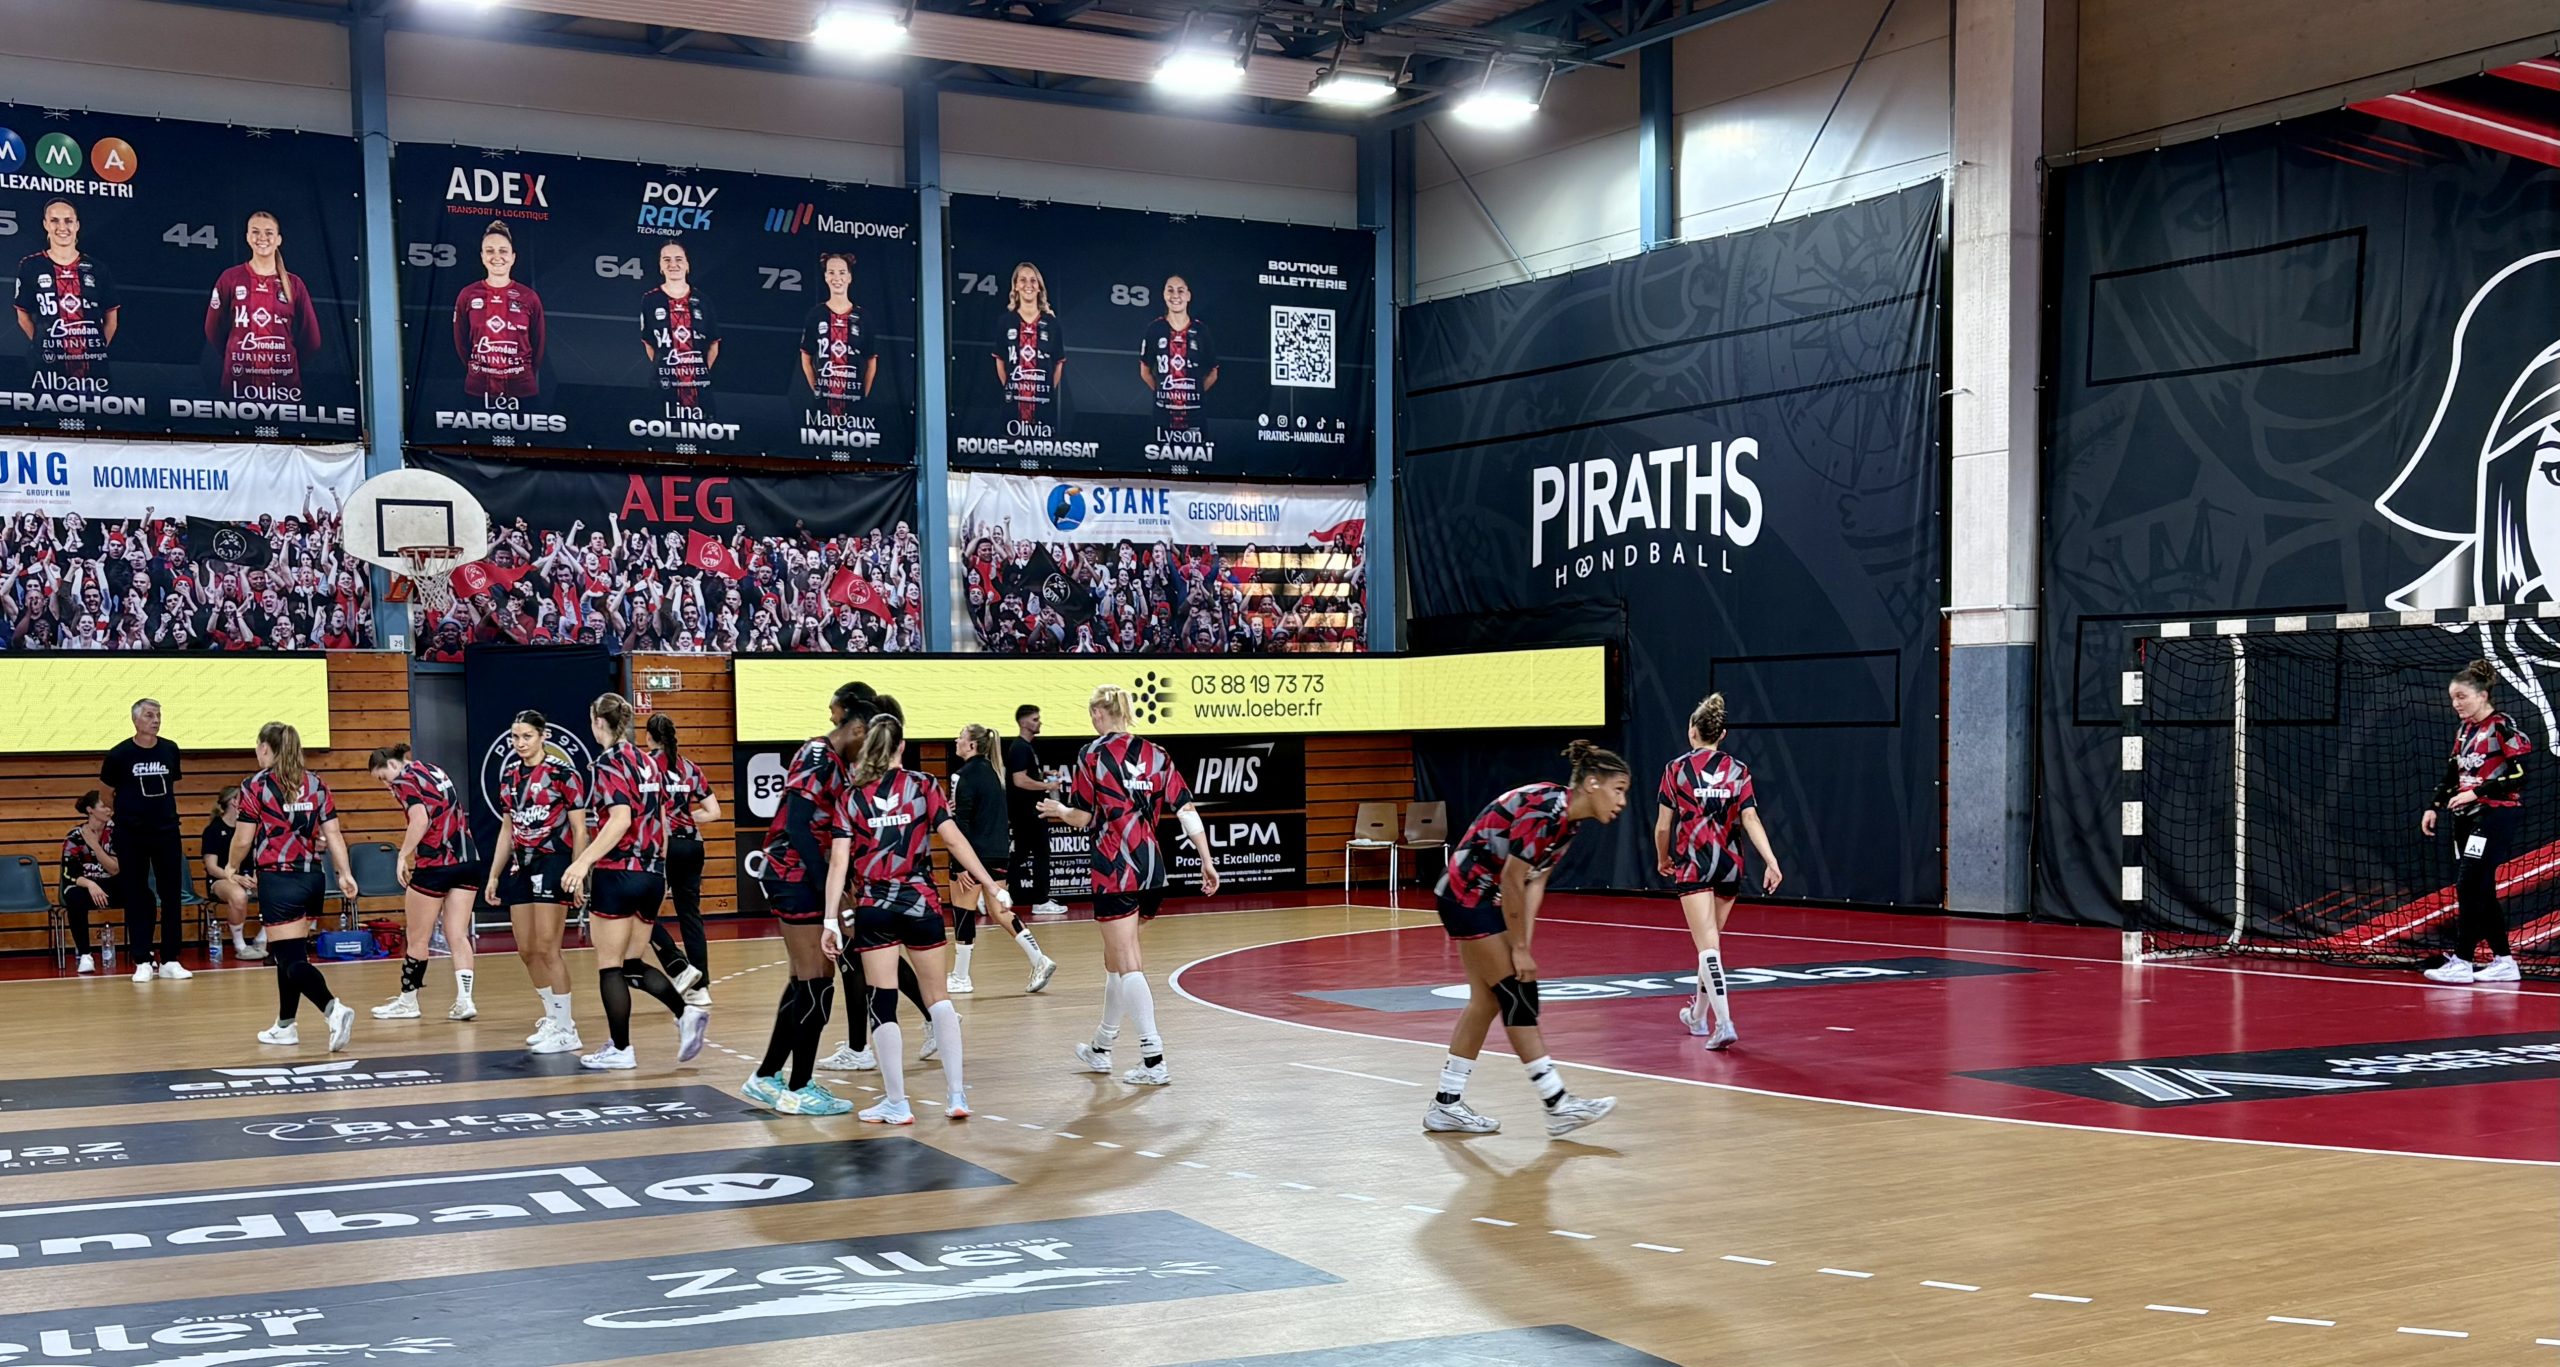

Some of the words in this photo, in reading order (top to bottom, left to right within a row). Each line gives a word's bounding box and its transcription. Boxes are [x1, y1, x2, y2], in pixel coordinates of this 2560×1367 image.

[0, 173, 86, 194] LEXANDRE
[89, 181, 133, 198] PETRI
[446, 166, 549, 208] ADEX
[643, 182, 719, 208] POLY
[447, 205, 493, 216] TRANSPORT
[503, 211, 549, 221] LOGISTIQUE
[638, 204, 714, 231] RACK
[162, 223, 219, 249] 44
[637, 226, 683, 237] TECH-GROUP
[817, 214, 906, 240] Manpower
[407, 243, 457, 268] 53
[594, 255, 644, 280] 64
[1268, 260, 1338, 275] BOUTIQUE
[758, 267, 802, 291] 72
[958, 273, 999, 296] 74
[1259, 274, 1347, 290] BILLETTERIE
[36, 292, 58, 316] 35
[1110, 284, 1150, 307] 83
[43, 338, 107, 349] EURINVES
[232, 352, 291, 362] EURINVEST
[31, 370, 110, 392] Albane
[233, 380, 302, 401] Louise
[817, 378, 862, 390] URINVEST
[170, 399, 356, 426] DENOYELLE
[484, 391, 520, 412] Léa
[664, 401, 704, 421] Lina
[435, 410, 568, 433] FARGUES
[628, 419, 741, 442] COLINOT
[804, 409, 876, 432] Margaux
[1006, 420, 1052, 437] Olivia
[800, 427, 881, 449] IMHOF
[1156, 425, 1203, 446] Lyson
[957, 437, 1100, 459] ROUGE-CARRASSAT
[1144, 441, 1216, 463] SAMAÏ
[93, 465, 230, 491] MOMMENHEIM
[619, 473, 735, 524] AEG
[1092, 486, 1170, 515] STANE
[1532, 436, 1763, 568] PIRATHS
[1188, 502, 1280, 522] GEISPOLSHEIM
[1191, 675, 1216, 694] 03
[1221, 675, 1246, 694] 88
[1250, 675, 1270, 693] 19
[1274, 675, 1298, 693] 73
[1302, 674, 1325, 693] 73
[1194, 698, 1323, 718] www.loeber.fr
[558, 735, 579, 756] 92
[1194, 756, 1261, 794] IPMS
[1693, 787, 1731, 799] erima
[868, 813, 911, 828] erima
[1223, 853, 1281, 865] Excellence
[168, 1069, 432, 1092] erima
[174, 1087, 318, 1100] SPORTSWEAR
[325, 1083, 385, 1091] SINCE
[331, 1101, 697, 1135] Butagaz
[345, 1131, 429, 1143] GAZ
[0, 1142, 126, 1162] az
[0, 1186, 642, 1258] ndball
[661, 1177, 781, 1196] TV
[941, 1237, 1061, 1252] énergies
[647, 1241, 1074, 1299] zeller
[173, 1307, 320, 1325] énergies
